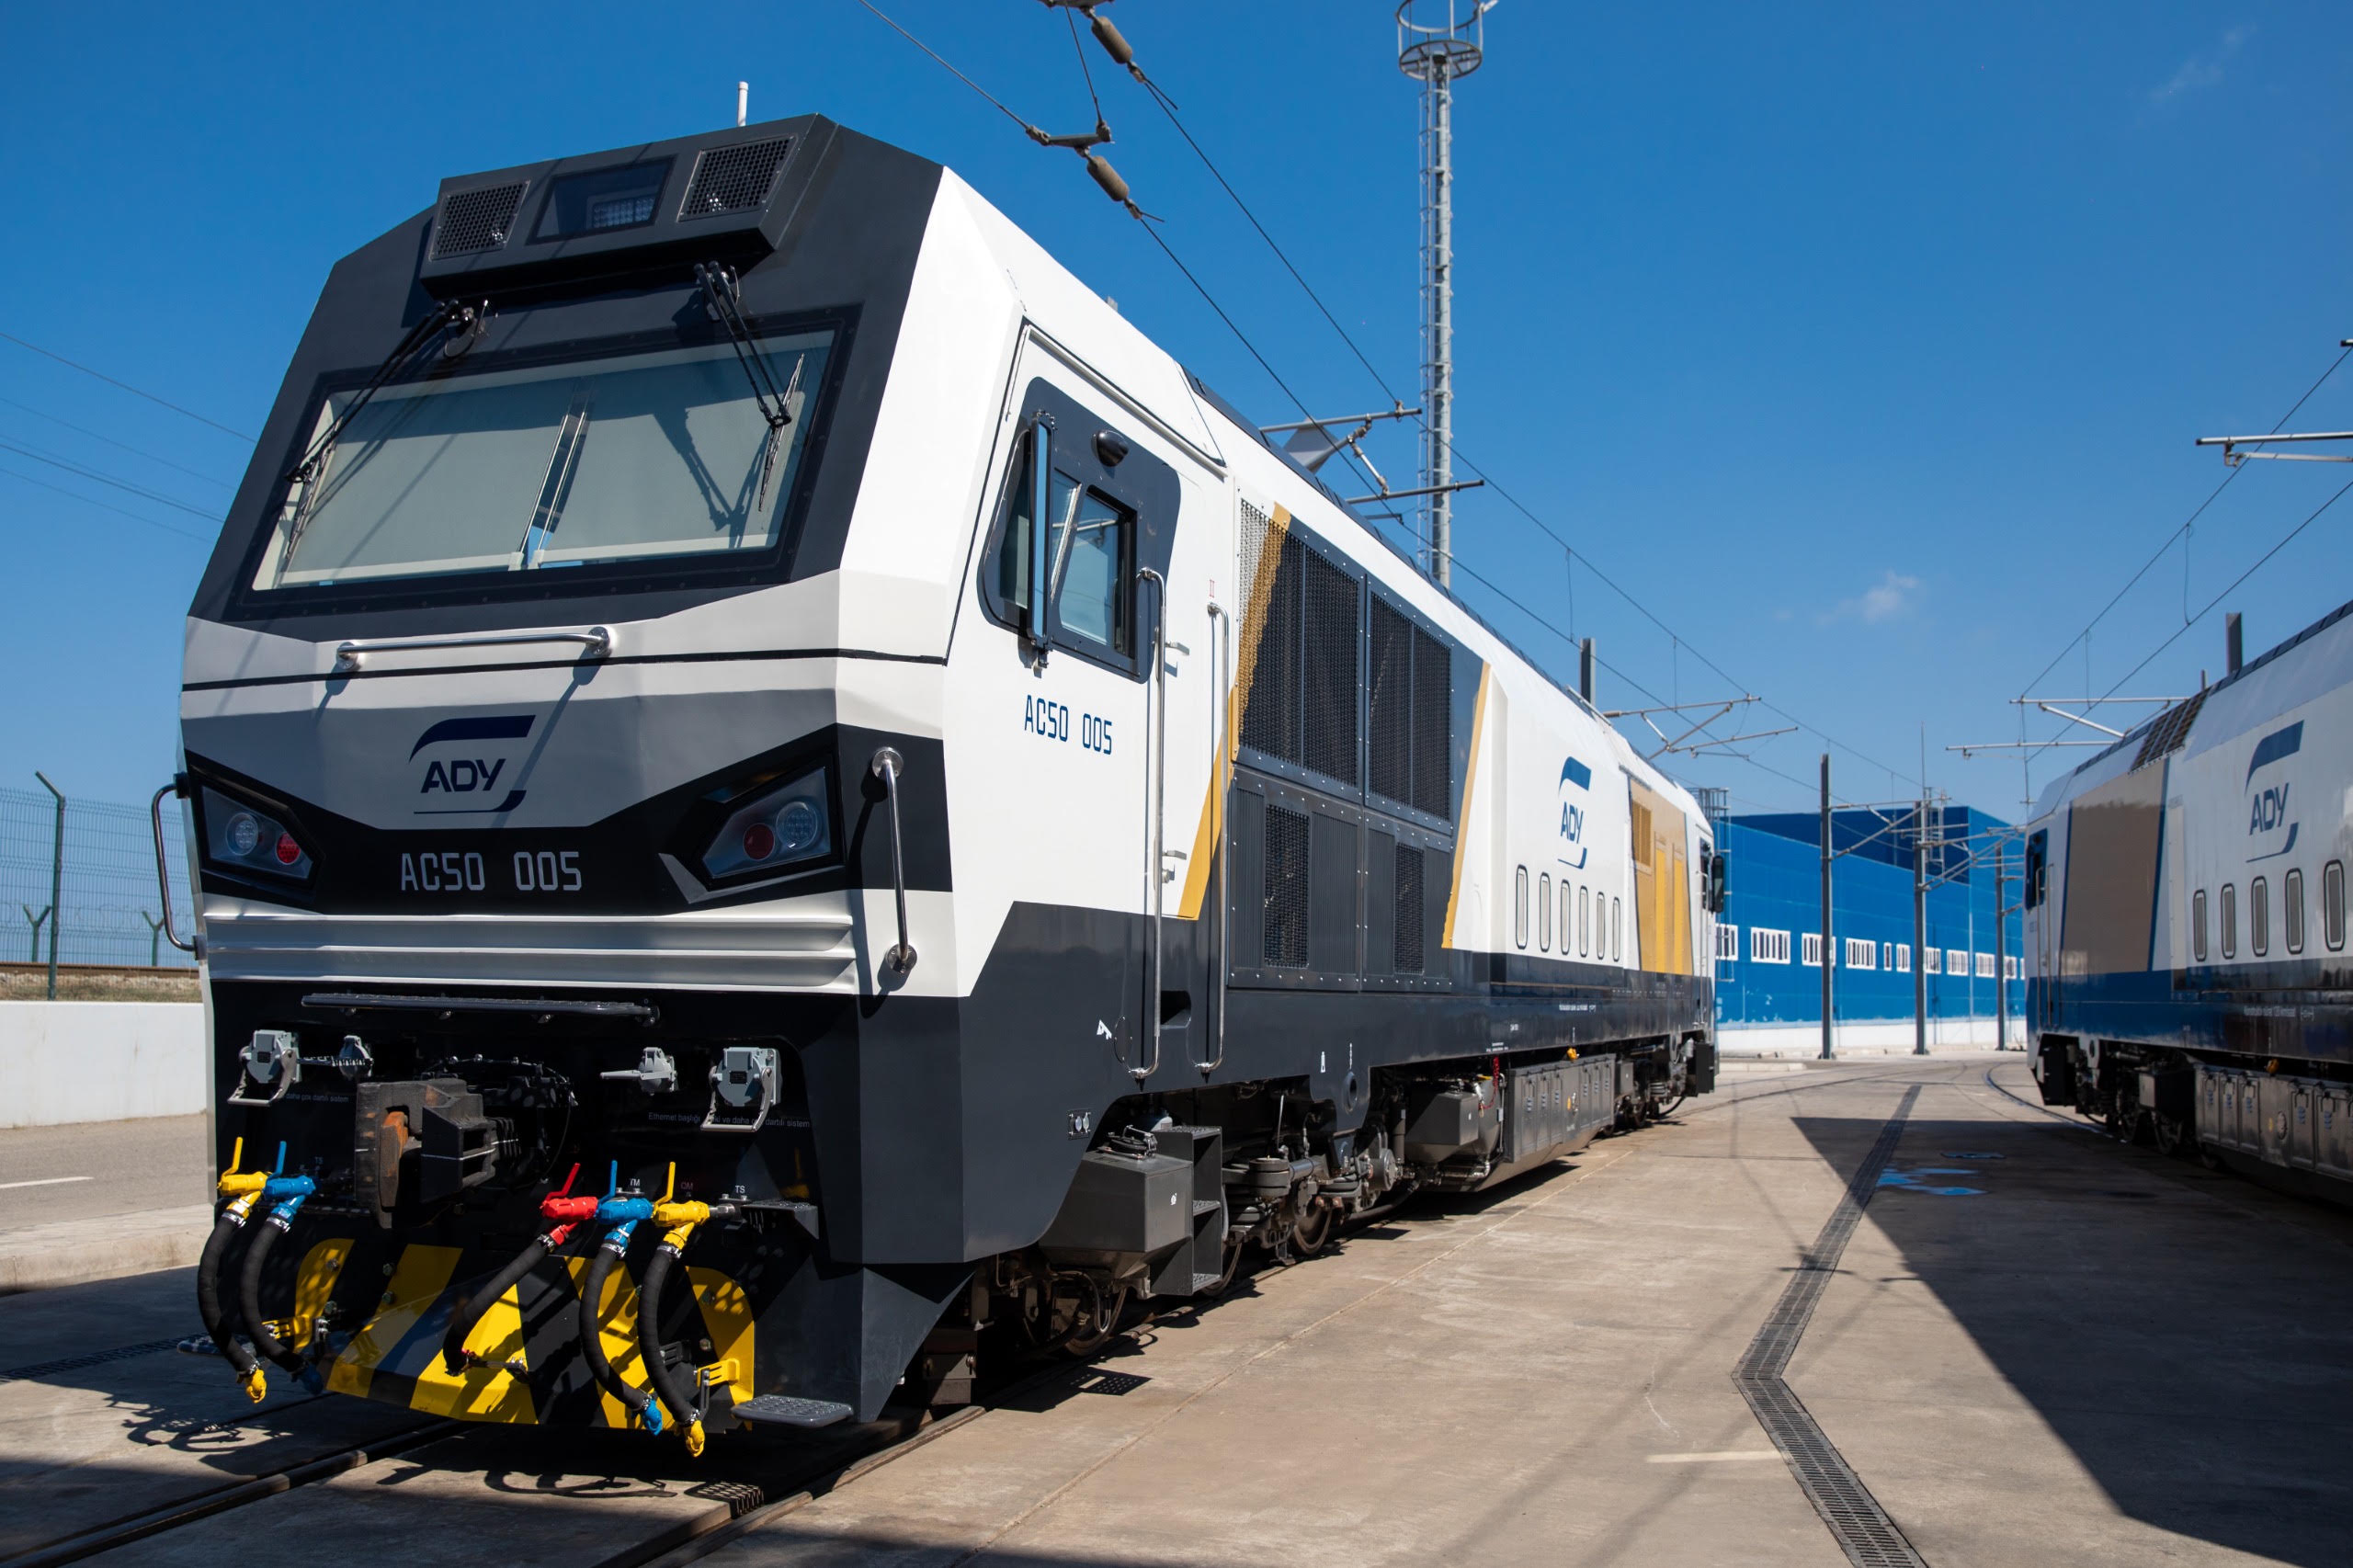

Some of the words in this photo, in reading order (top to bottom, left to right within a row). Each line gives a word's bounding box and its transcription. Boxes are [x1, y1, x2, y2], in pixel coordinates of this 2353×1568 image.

[1024, 694, 1068, 742] AC50
[1082, 713, 1112, 755] 005
[420, 758, 506, 793] ADY
[1560, 801, 1584, 845] ADY
[2248, 782, 2290, 835] ADY
[401, 852, 485, 891] AC50
[513, 851, 582, 891] 005
[648, 1112, 677, 1121] Ethernet
[732, 1116, 750, 1124] daha
[786, 1119, 810, 1128] sistem
[735, 1185, 745, 1194] TS
